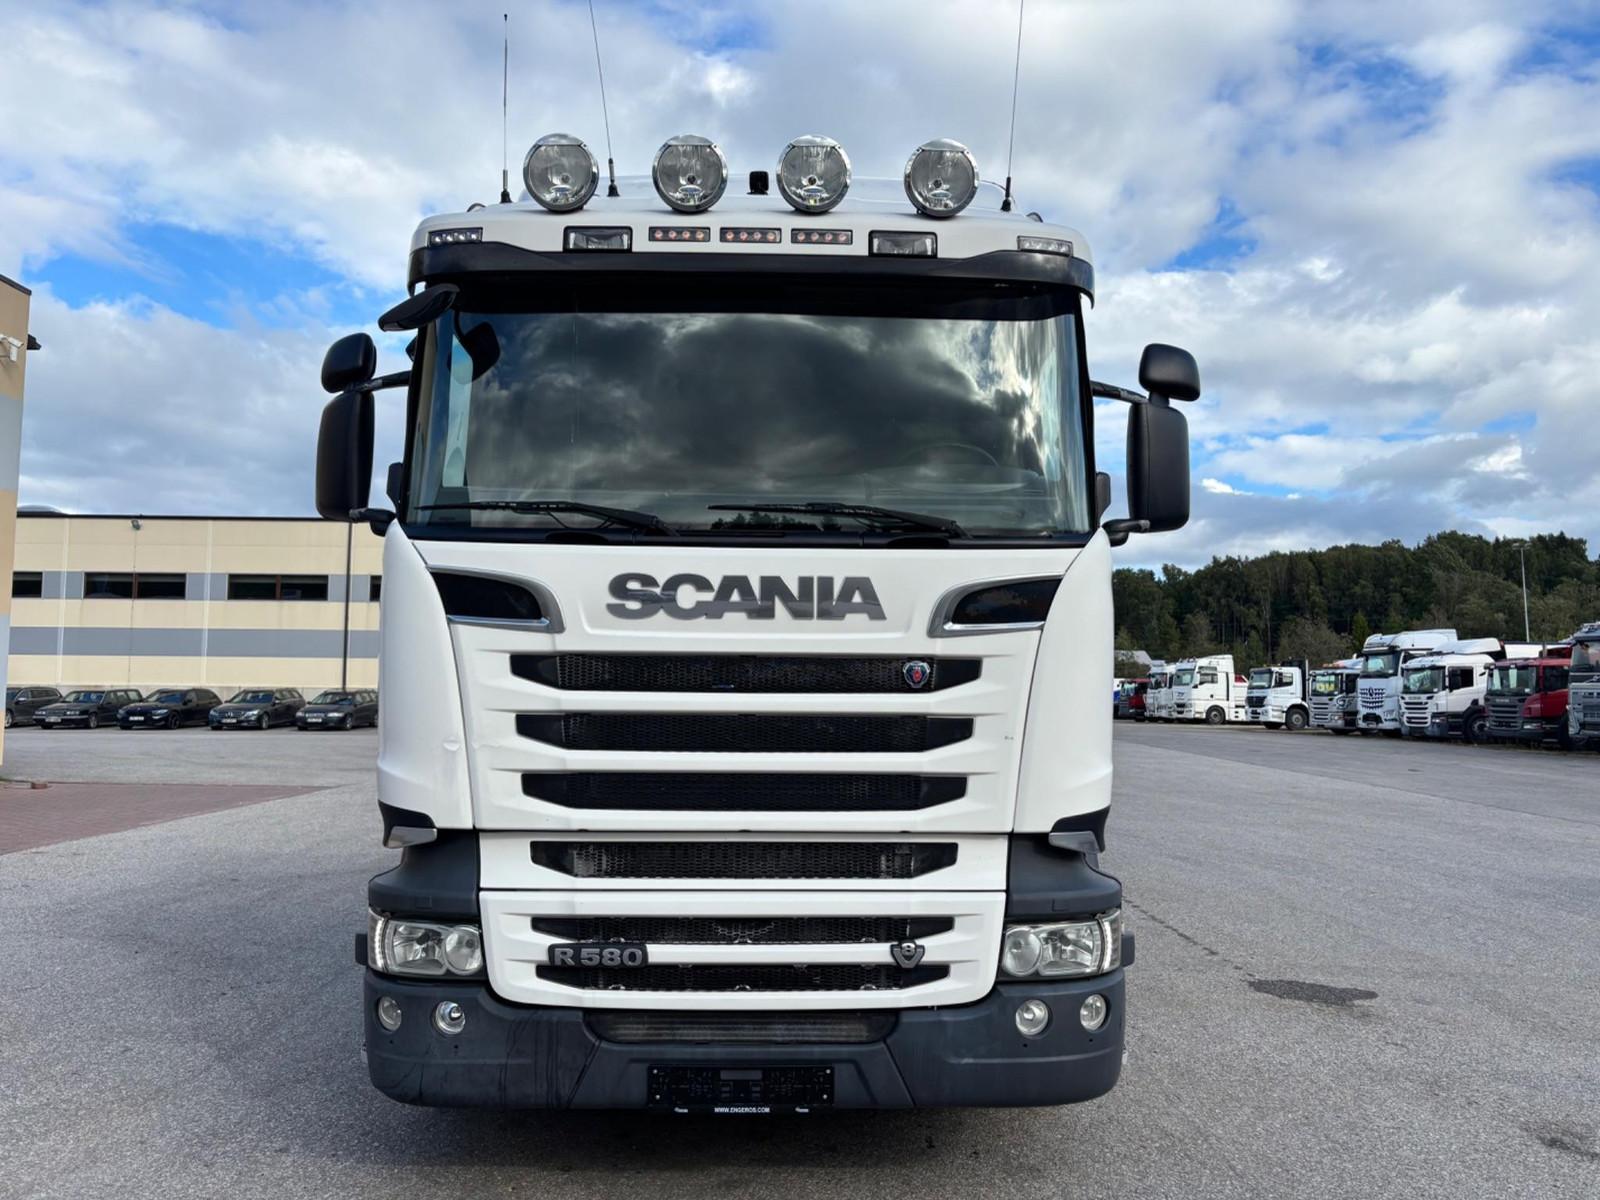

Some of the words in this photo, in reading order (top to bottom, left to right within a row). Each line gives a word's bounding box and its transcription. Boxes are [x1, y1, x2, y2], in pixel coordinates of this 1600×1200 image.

[606, 572, 887, 620] SCANIA
[553, 947, 576, 966] R
[580, 947, 643, 966] 580
